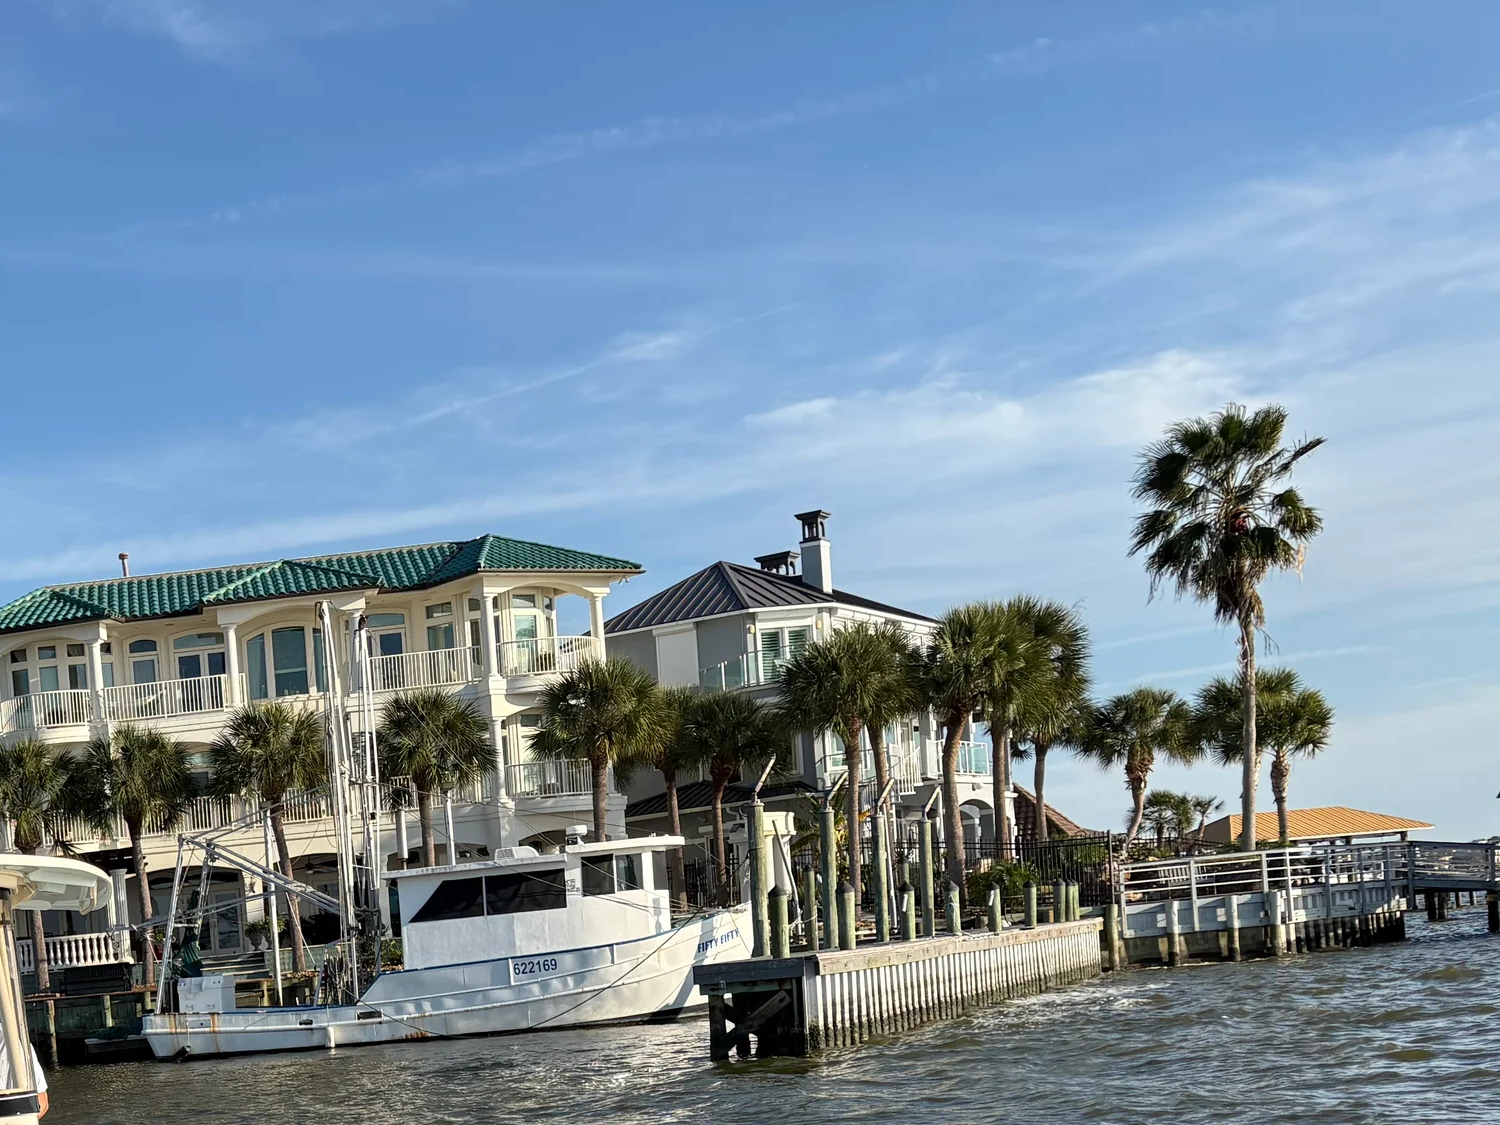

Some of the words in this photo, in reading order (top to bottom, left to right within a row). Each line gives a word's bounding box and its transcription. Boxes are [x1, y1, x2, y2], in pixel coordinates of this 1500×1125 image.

[698, 937, 719, 953] FIFTY
[720, 927, 739, 944] FIFTY
[513, 958, 557, 975] 622169
